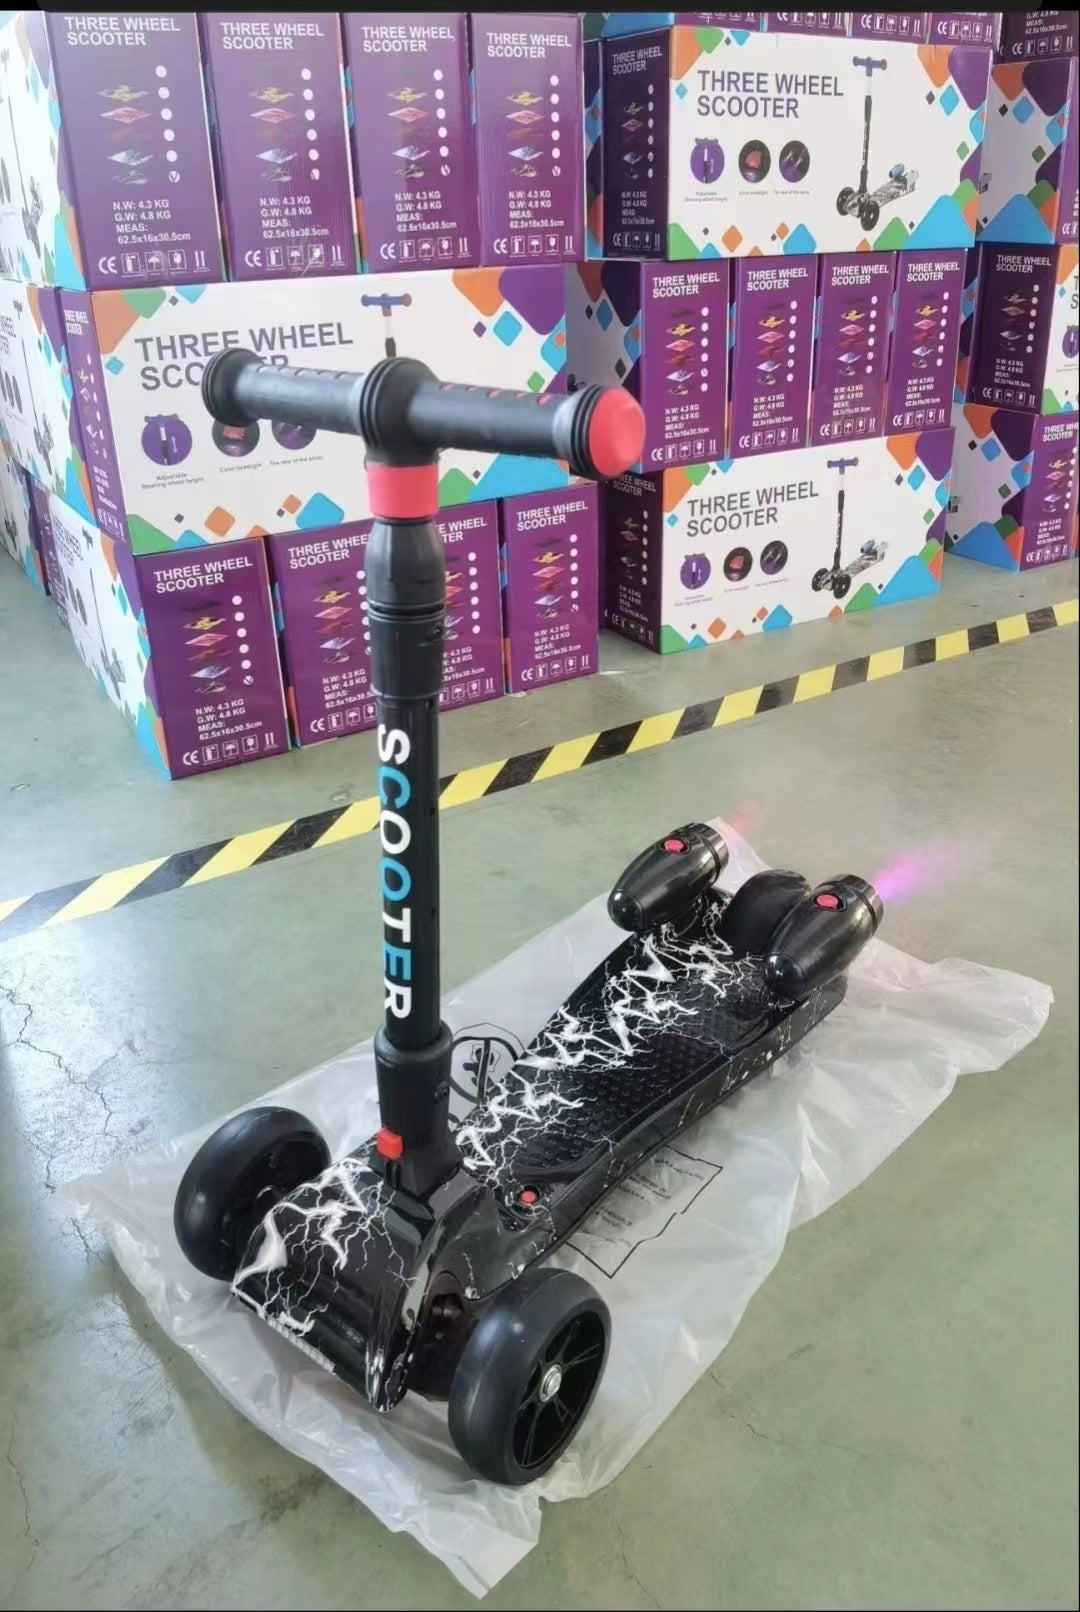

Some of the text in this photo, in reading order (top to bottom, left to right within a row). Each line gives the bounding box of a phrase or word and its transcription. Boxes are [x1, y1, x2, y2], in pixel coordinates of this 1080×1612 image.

[64, 15, 180, 31] THREE WHEEL
[220, 22, 324, 36] THREE WHEEL
[67, 31, 146, 46] SCOOTER
[361, 26, 455, 40] THREE WHEEL
[486, 32, 572, 47] THREE WHEEL
[222, 36, 294, 49] SCOOTER
[363, 39, 427, 52] SCOOTER
[487, 45, 546, 58] SCOOTER
[612, 46, 663, 64] THREE WHEEL
[612, 60, 647, 75] SCOOTER
[697, 70, 844, 96] THREE WHEEL
[697, 95, 799, 118] SCOOTER
[282, 196, 296, 205] 4.3
[297, 195, 311, 204] KG
[429, 191, 441, 199] KG
[138, 200, 152, 209] 4.3
[155, 199, 169, 208] KG
[430, 201, 442, 209] KG
[140, 211, 154, 220] 4.8
[156, 210, 171, 219] KG
[284, 207, 297, 216] 4.8
[299, 207, 312, 215] KG
[116, 223, 148, 233] MEAS:
[380, 243, 396, 259] CE
[493, 238, 508, 254] CE
[98, 256, 118, 274] CE
[245, 250, 262, 267] CE
[997, 255, 1051, 266] THREE WHEEL
[747, 267, 808, 281] THREE WHEEL
[832, 264, 889, 276] THREE WHEEL
[908, 261, 960, 273] THREE WHEEL
[996, 263, 1033, 273] SCOOTER
[653, 272, 720, 288] THREE WHEEL
[831, 275, 871, 286] SCOOTER
[907, 272, 943, 282] SCOOTER
[653, 284, 699, 298] SCOOTER
[747, 279, 789, 291] SCOOTER
[134, 322, 353, 362] THREE WHEEL
[1044, 424, 1065, 434] THREE
[739, 435, 750, 448] CE
[1043, 431, 1073, 442] SCOOTER
[651, 448, 663, 461] CE
[687, 481, 818, 517] THREE WHEEL
[516, 500, 588, 521] THREE WHEEL
[449, 517, 487, 531] WHEEL
[517, 514, 566, 531] SCOOTER
[686, 507, 778, 537] SCOOTER
[288, 533, 369, 558] THREE WHEE
[290, 549, 350, 569] SCOOTER
[154, 556, 253, 582] THREE WHEEL
[156, 573, 224, 594] SCOOTER
[354, 668, 365, 676] KG
[521, 668, 533, 681] CE
[355, 676, 367, 685] KG
[231, 698, 244, 707] KG
[233, 707, 246, 715] KG
[198, 721, 225, 732] MEAS:
[310, 718, 325, 732] CE
[183, 750, 199, 765] CE
[377, 724, 412, 1019] SCOOTER
